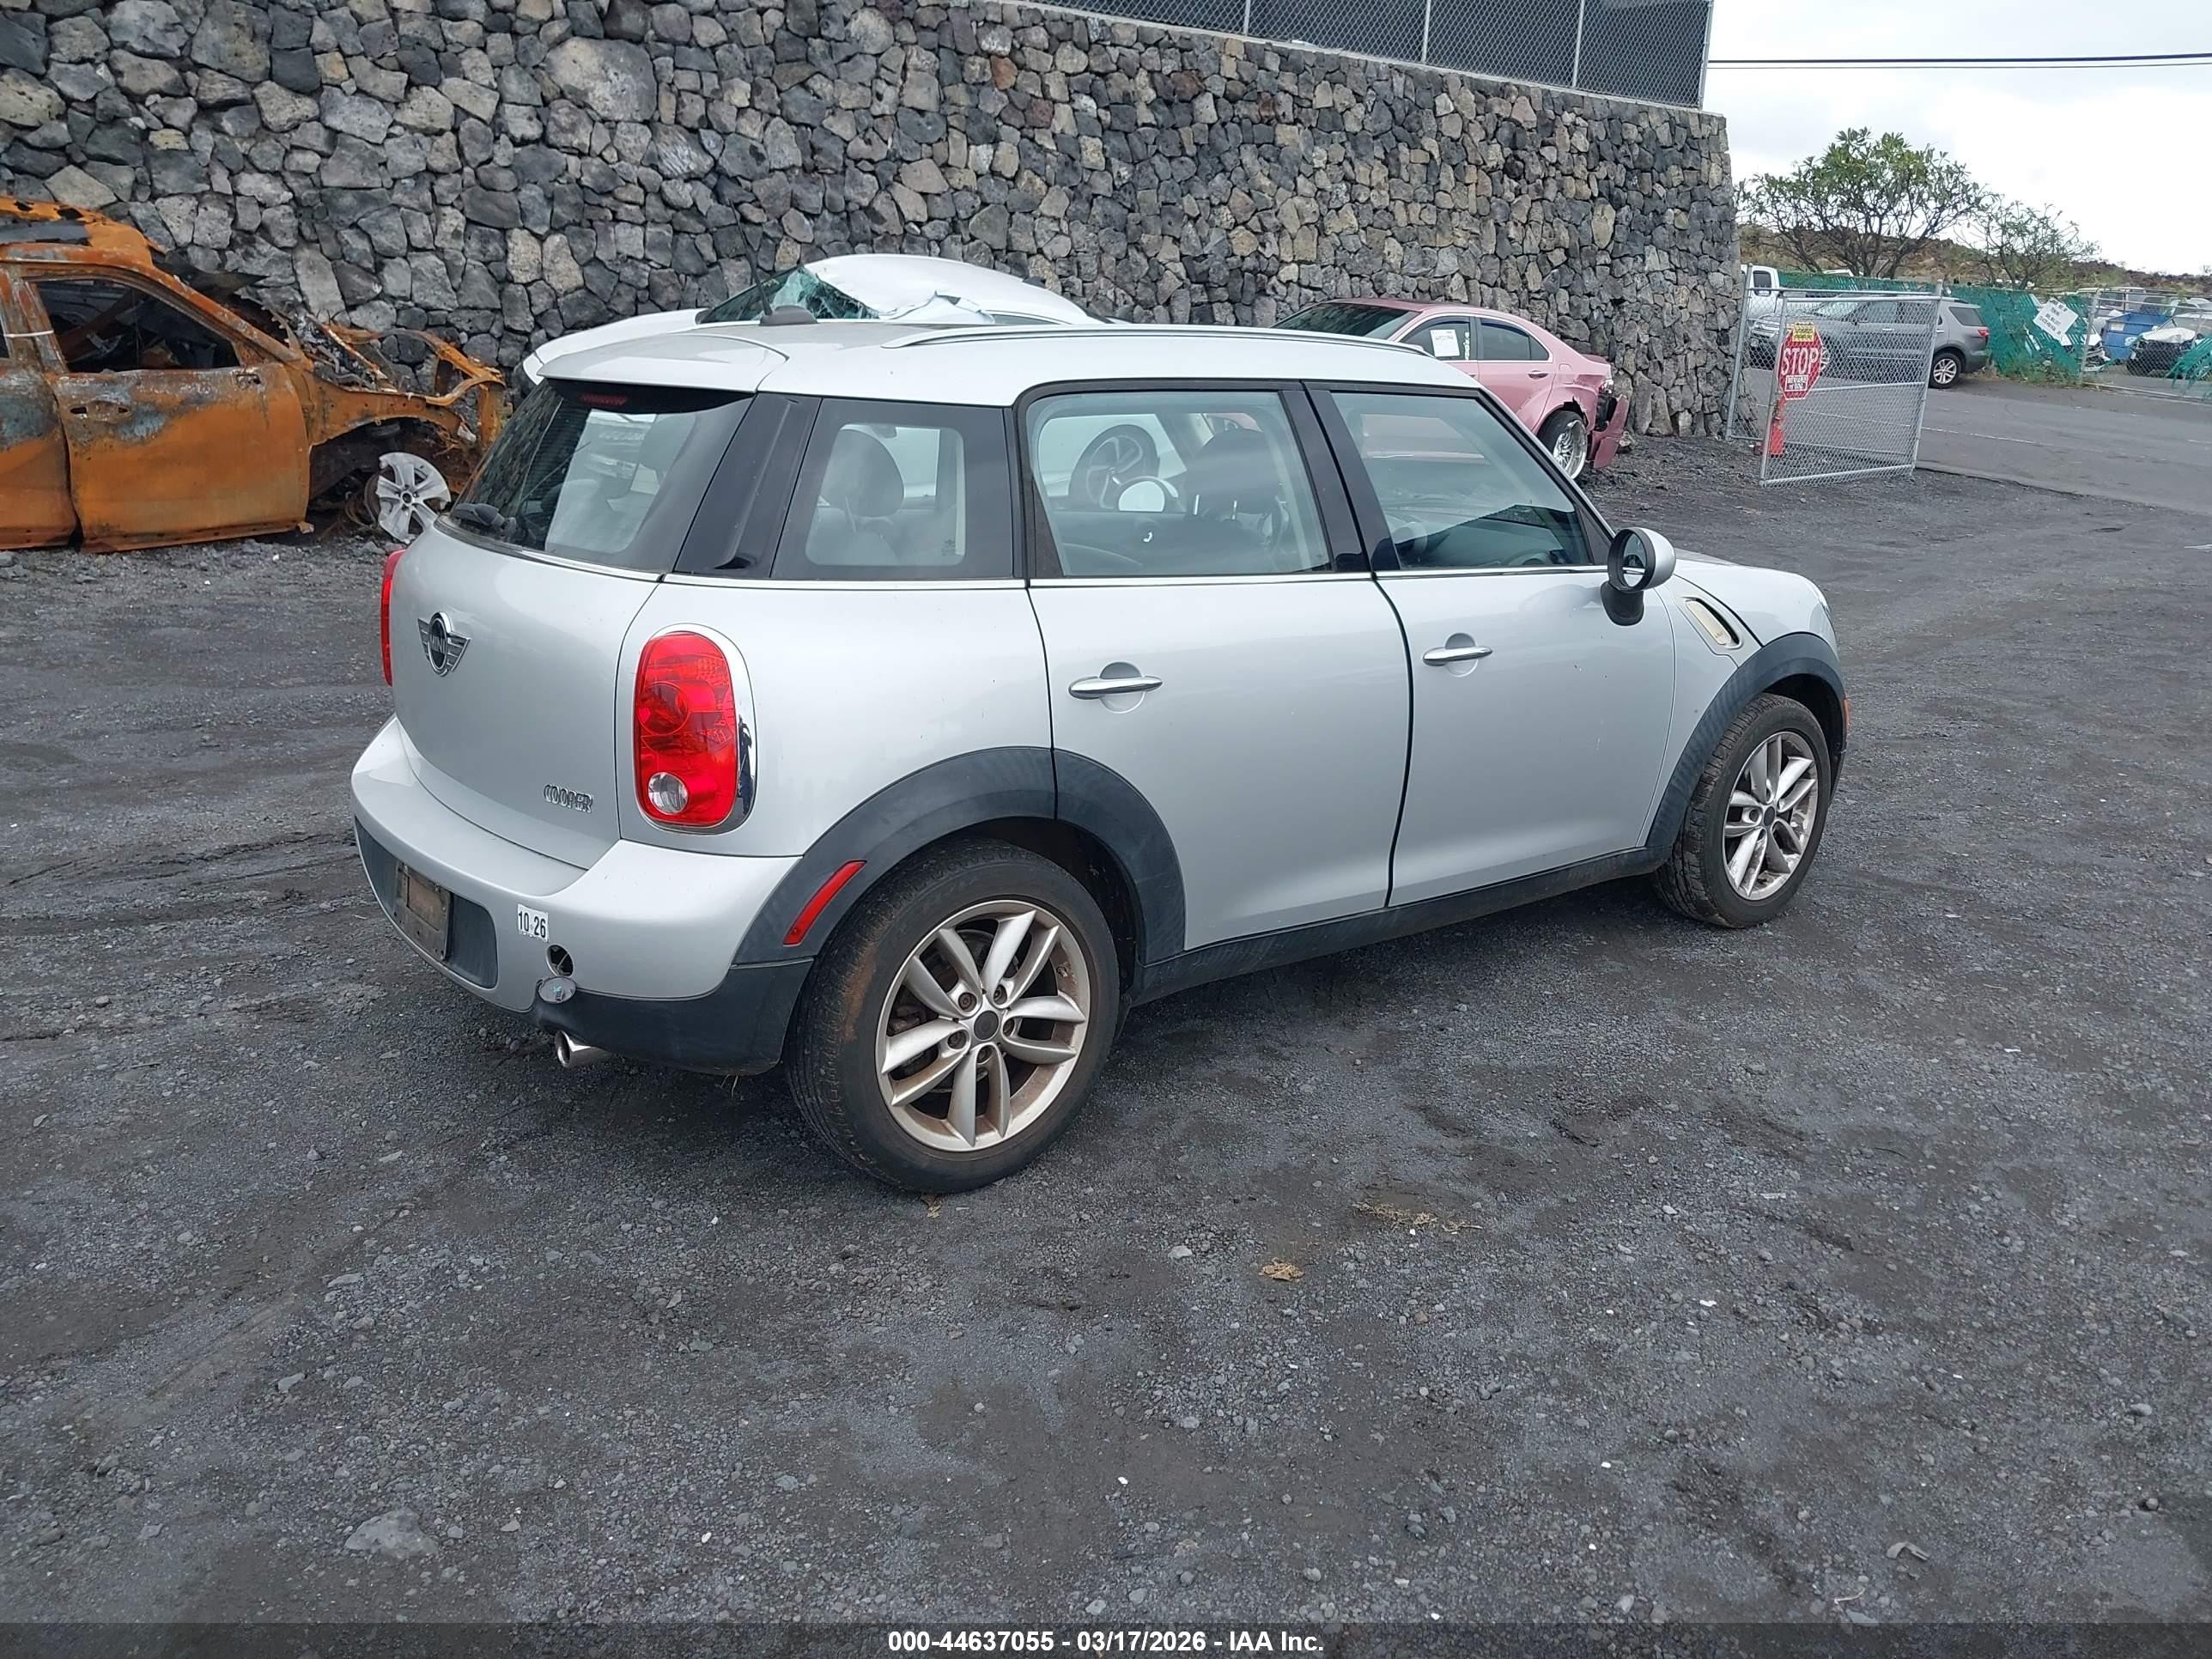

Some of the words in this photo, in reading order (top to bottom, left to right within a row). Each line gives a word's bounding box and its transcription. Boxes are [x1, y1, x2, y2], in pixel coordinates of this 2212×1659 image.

[1781, 347, 1819, 375] STOP
[430, 634, 446, 655] MINI
[544, 784, 592, 813] COOPER
[519, 911, 529, 932] 10
[534, 915, 546, 939] 26
